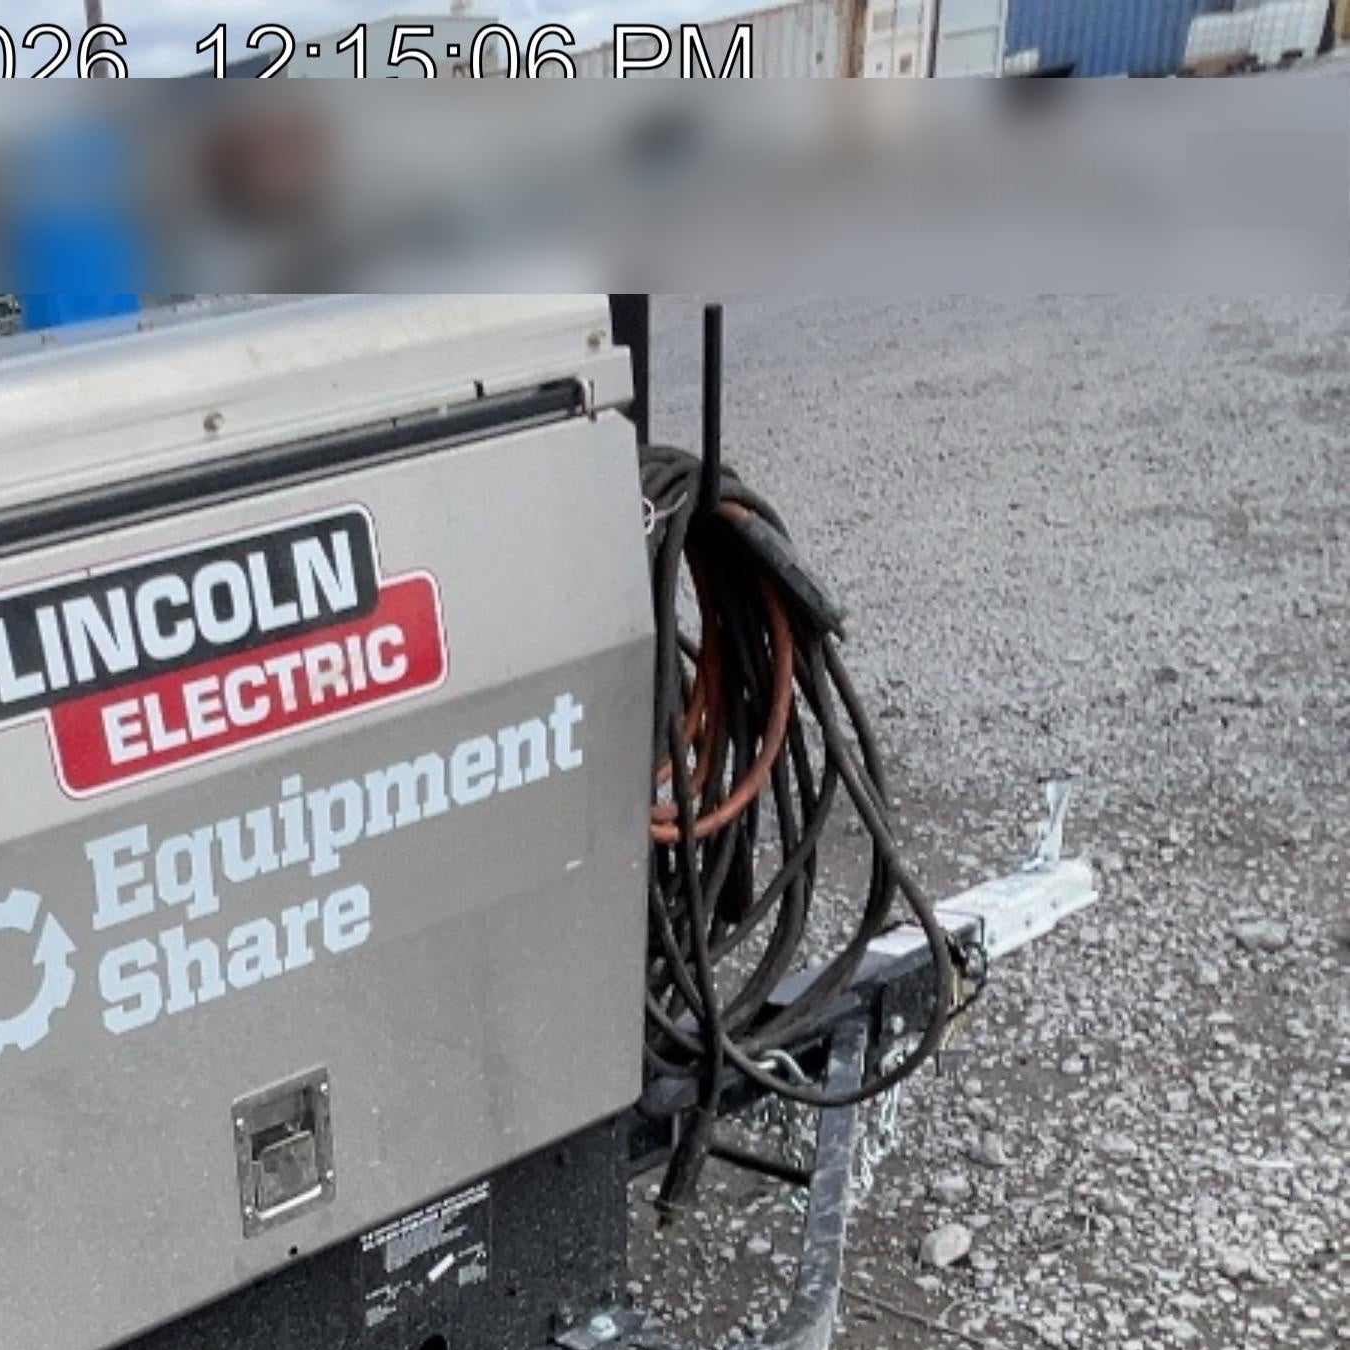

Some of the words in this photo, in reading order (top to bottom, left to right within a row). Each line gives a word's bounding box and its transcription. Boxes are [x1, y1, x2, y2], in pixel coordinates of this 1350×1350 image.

[101, 624, 408, 766] ELECTRIC
[84, 691, 584, 931] Equipment
[96, 883, 371, 1035] Share
